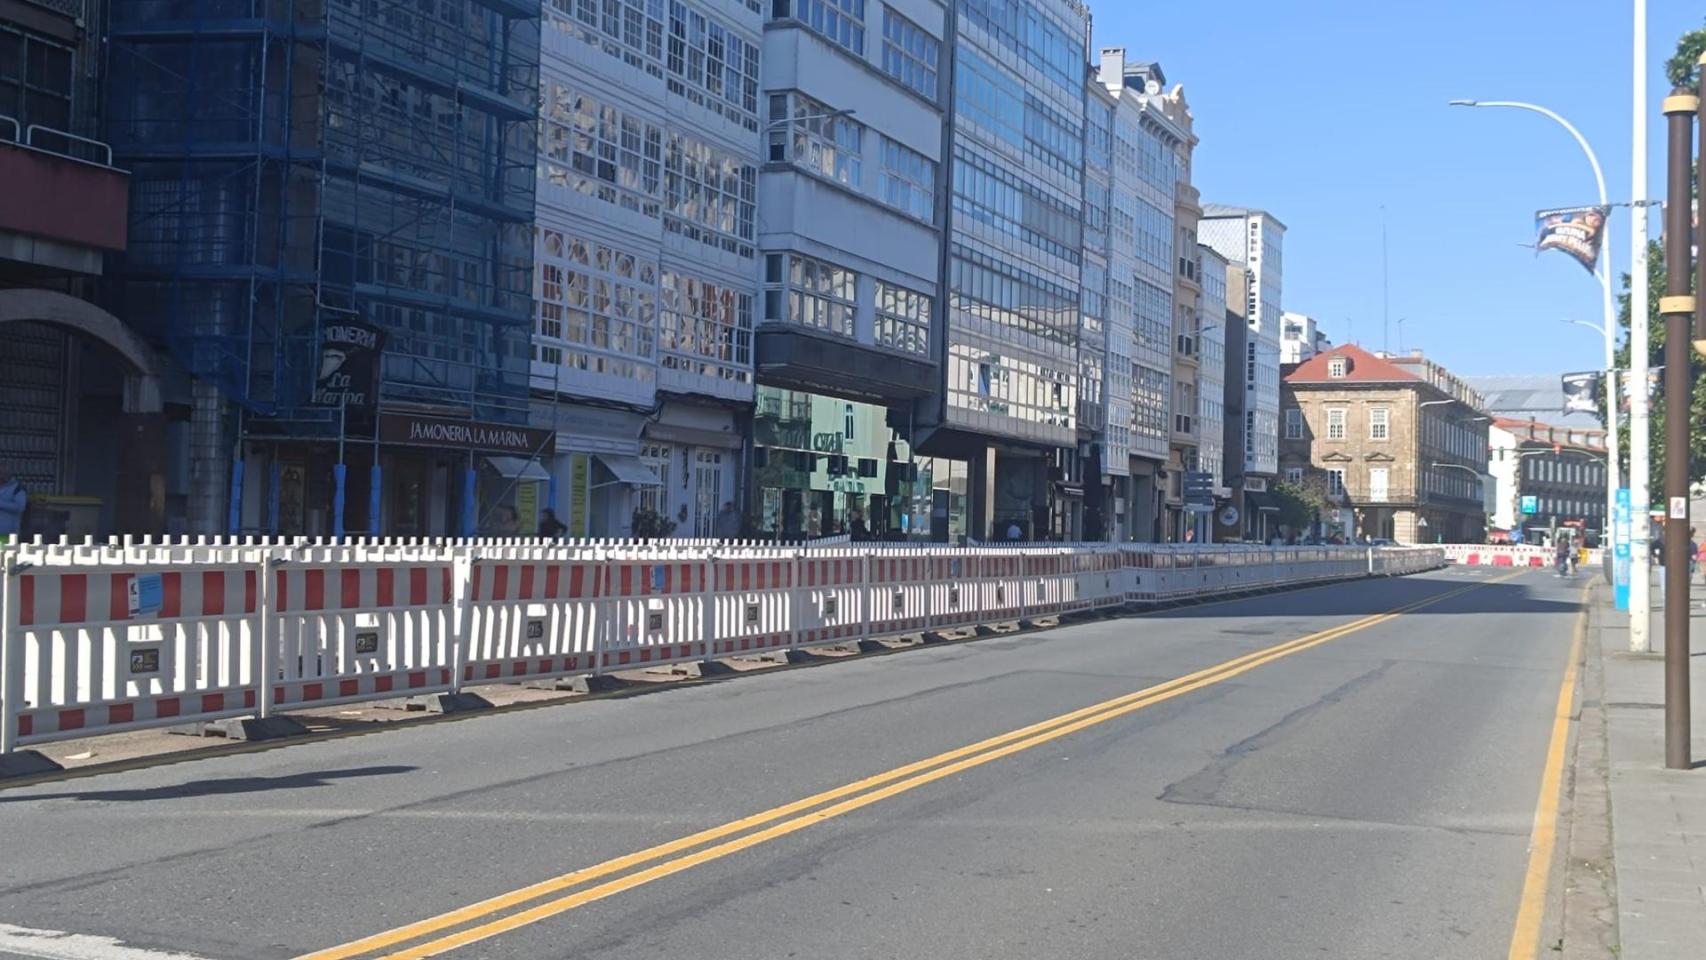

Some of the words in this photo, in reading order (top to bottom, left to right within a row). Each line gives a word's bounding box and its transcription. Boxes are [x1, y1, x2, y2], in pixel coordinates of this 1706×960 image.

[409, 421, 472, 442] JAMONERIA
[474, 427, 486, 443] LA
[488, 430, 529, 448] MARINA
